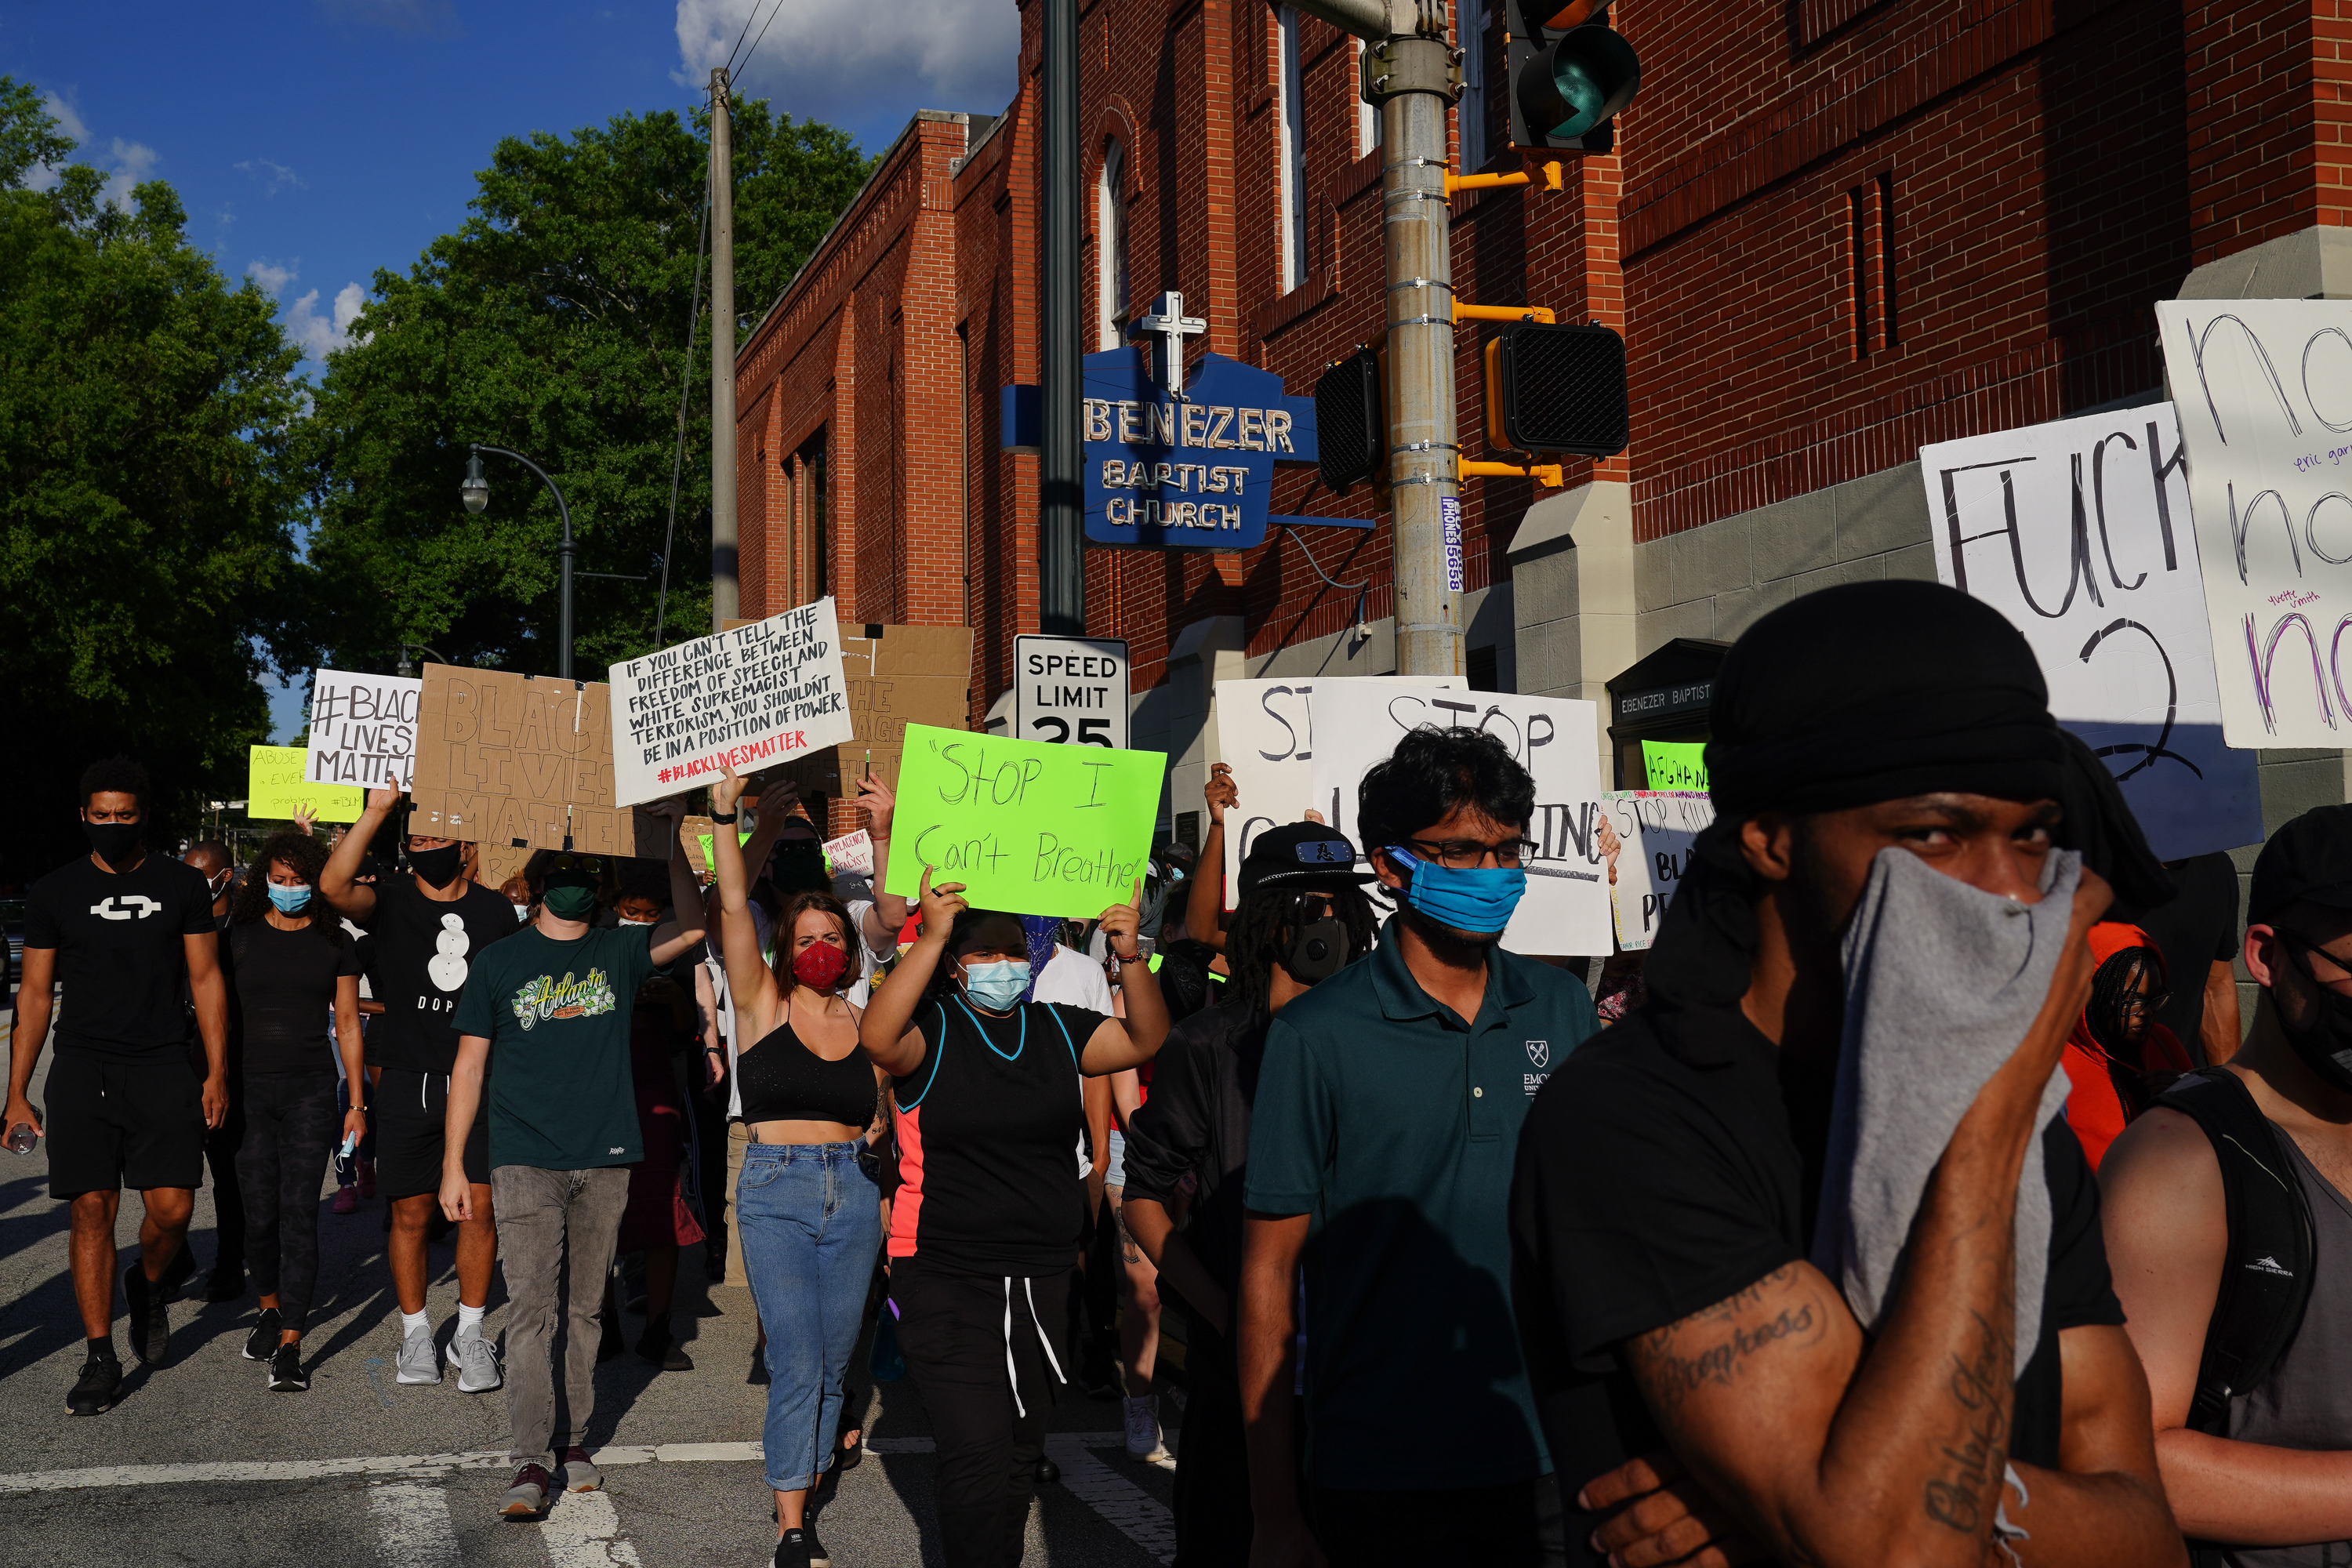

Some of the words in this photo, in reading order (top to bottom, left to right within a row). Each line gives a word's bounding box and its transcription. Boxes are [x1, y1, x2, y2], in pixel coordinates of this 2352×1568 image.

[1103, 459, 1250, 495] BAPTIST
[1106, 497, 1242, 531] CHURCH
[1443, 499, 1457, 544] IPHONES
[1940, 420, 2187, 619] FUCK
[1447, 546, 1460, 590] 5658
[627, 662, 641, 678] IF
[648, 651, 677, 673] YOU
[683, 633, 726, 662] CAN'T
[732, 622, 775, 647] TELL
[780, 605, 817, 632] THE
[637, 651, 733, 693] DIFFERENCE
[741, 626, 814, 663] BETWEEN
[629, 679, 702, 713] FREEDOM
[707, 671, 727, 691] OF
[732, 652, 793, 686] SPEECH
[797, 641, 828, 665] AND
[1028, 654, 1117, 678] SPEED
[629, 702, 685, 731] WHITE
[691, 665, 802, 713] SUPREMACIST
[1037, 685, 1109, 709] LIMIT
[1622, 693, 1665, 713] EBENEZER
[1673, 684, 1711, 704] BAPTIST
[340, 723, 412, 755] LIVES
[630, 709, 730, 746] TERRORISM,
[731, 699, 757, 720] YOU
[644, 748, 662, 765] BE
[666, 739, 681, 759] IN
[684, 735, 695, 753] A
[699, 717, 771, 746] POSITION
[775, 706, 791, 726] OF
[794, 691, 846, 722] POWER.
[252, 750, 299, 765] ABUSE
[270, 768, 306, 786] EVER
[315, 750, 415, 786] MATTER
[449, 742, 616, 808] LIVES
[657, 730, 808, 784] #BLACKLIVESMATTER
[270, 797, 318, 810] problem
[331, 796, 362, 808] #BLM
[1074, 762, 1113, 808] I
[443, 792, 655, 858] MATTER
[1616, 798, 1670, 840] STOP
[822, 832, 864, 855] OMPLACENCY
[830, 855, 839, 865] IS
[846, 851, 852, 859] A
[914, 824, 1011, 876] Can't
[417, 996, 452, 1012] DOP
[521, 967, 607, 1031] Atlanta
[2265, 1268, 2294, 1277] SIERRA
